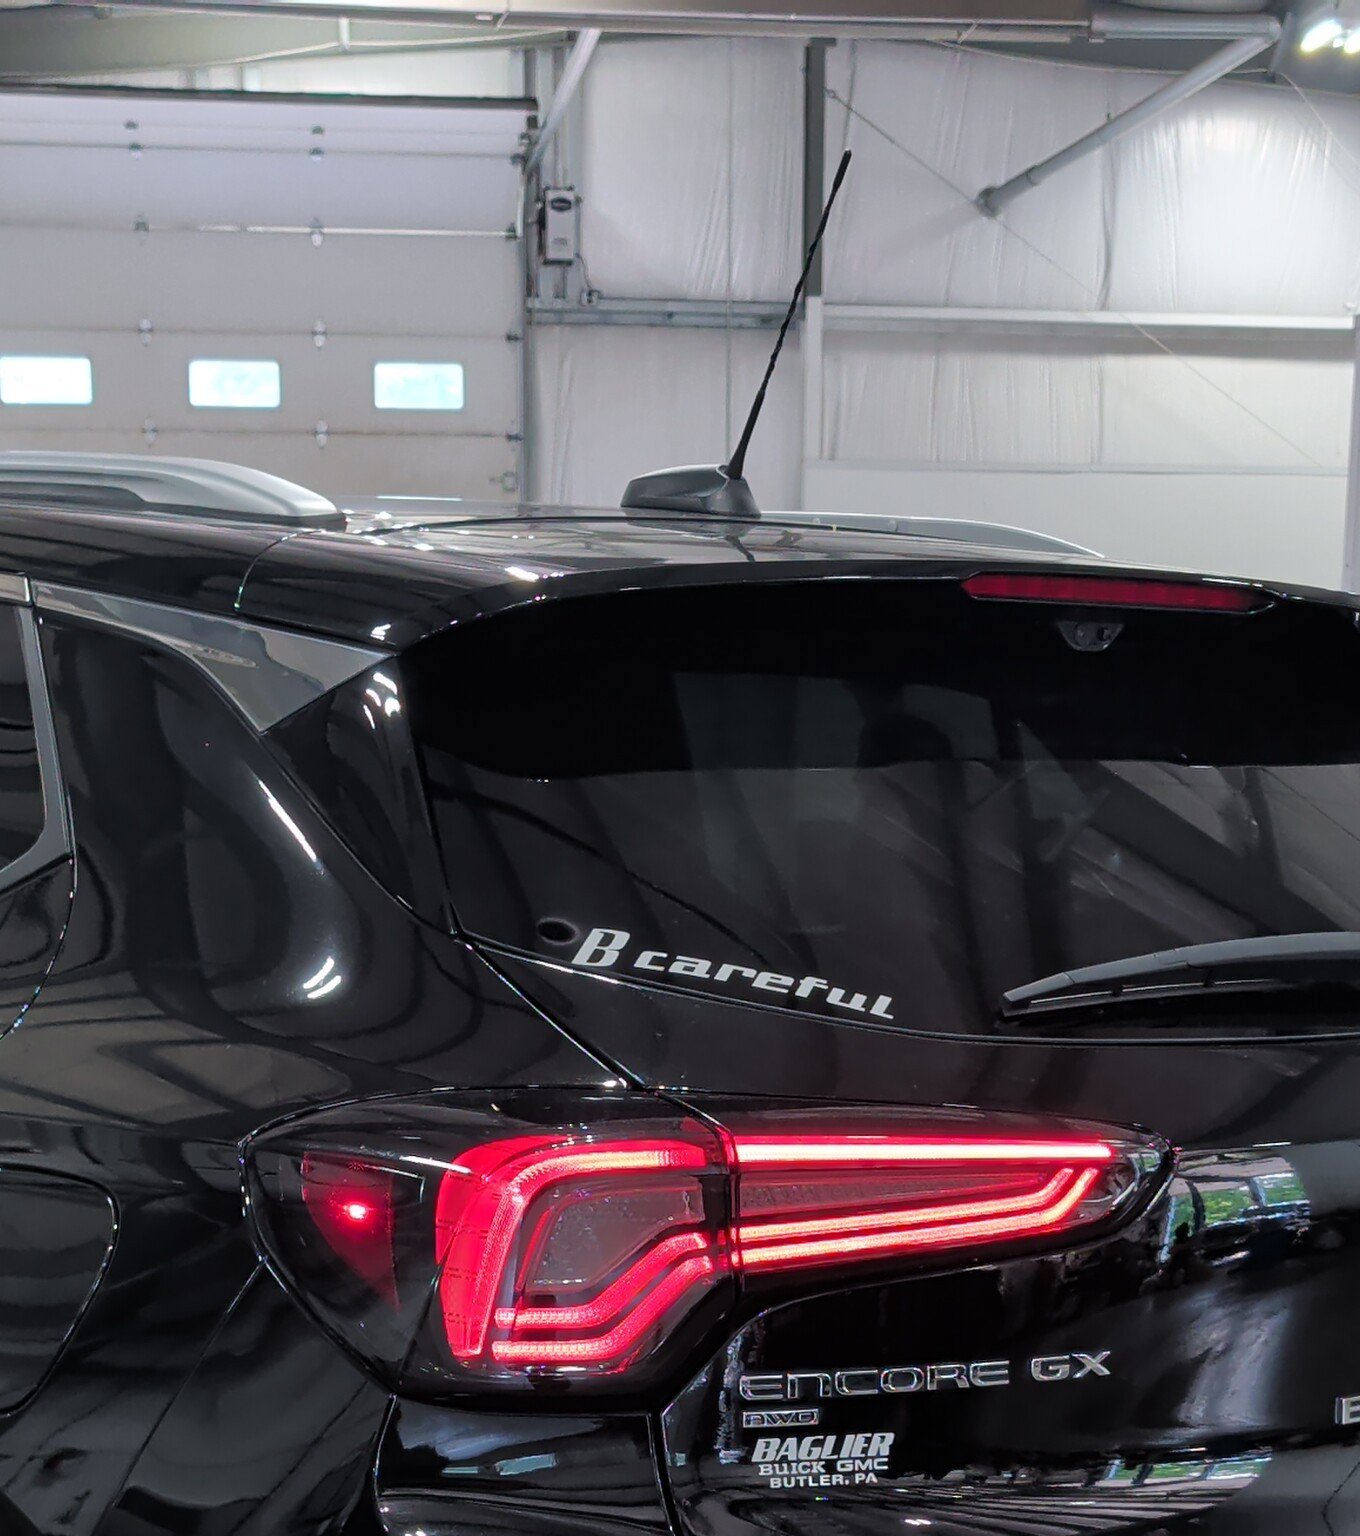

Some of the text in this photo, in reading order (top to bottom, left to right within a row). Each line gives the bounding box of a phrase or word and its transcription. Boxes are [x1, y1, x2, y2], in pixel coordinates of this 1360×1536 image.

[570, 927, 895, 1020] B careful
[739, 1350, 1111, 1401] ENCORE GX
[744, 1410, 818, 1428] AWD
[751, 1432, 895, 1463] BAGLIER
[758, 1457, 889, 1477] BUICK GMC
[854, 1472, 878, 1484] PA
